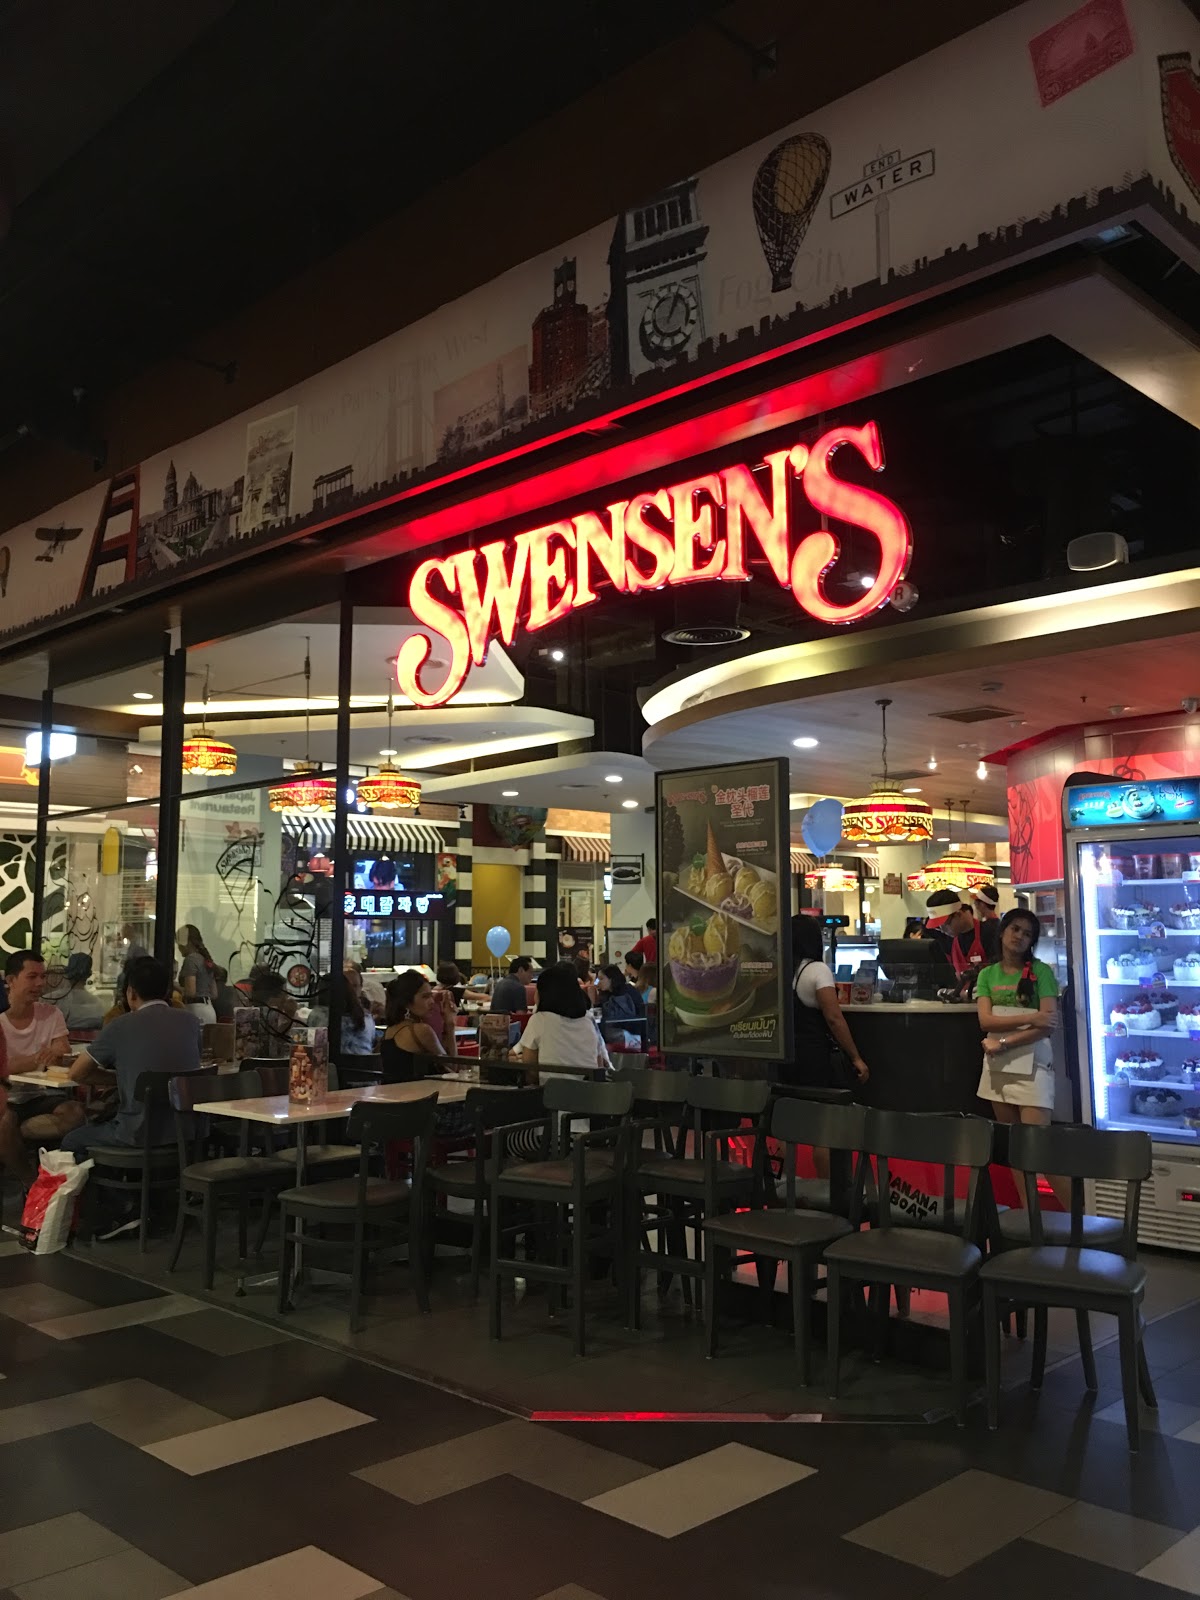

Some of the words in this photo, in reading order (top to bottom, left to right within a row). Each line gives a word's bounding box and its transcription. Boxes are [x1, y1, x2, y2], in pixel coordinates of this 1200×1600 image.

[870, 155, 894, 174] END
[844, 160, 922, 206] WATER
[397, 419, 911, 709] SWENSEN'S
[715, 784, 770, 806] 金枕头榴莲
[731, 802, 754, 818] 圣代
[889, 1190, 928, 1220] BOAT
